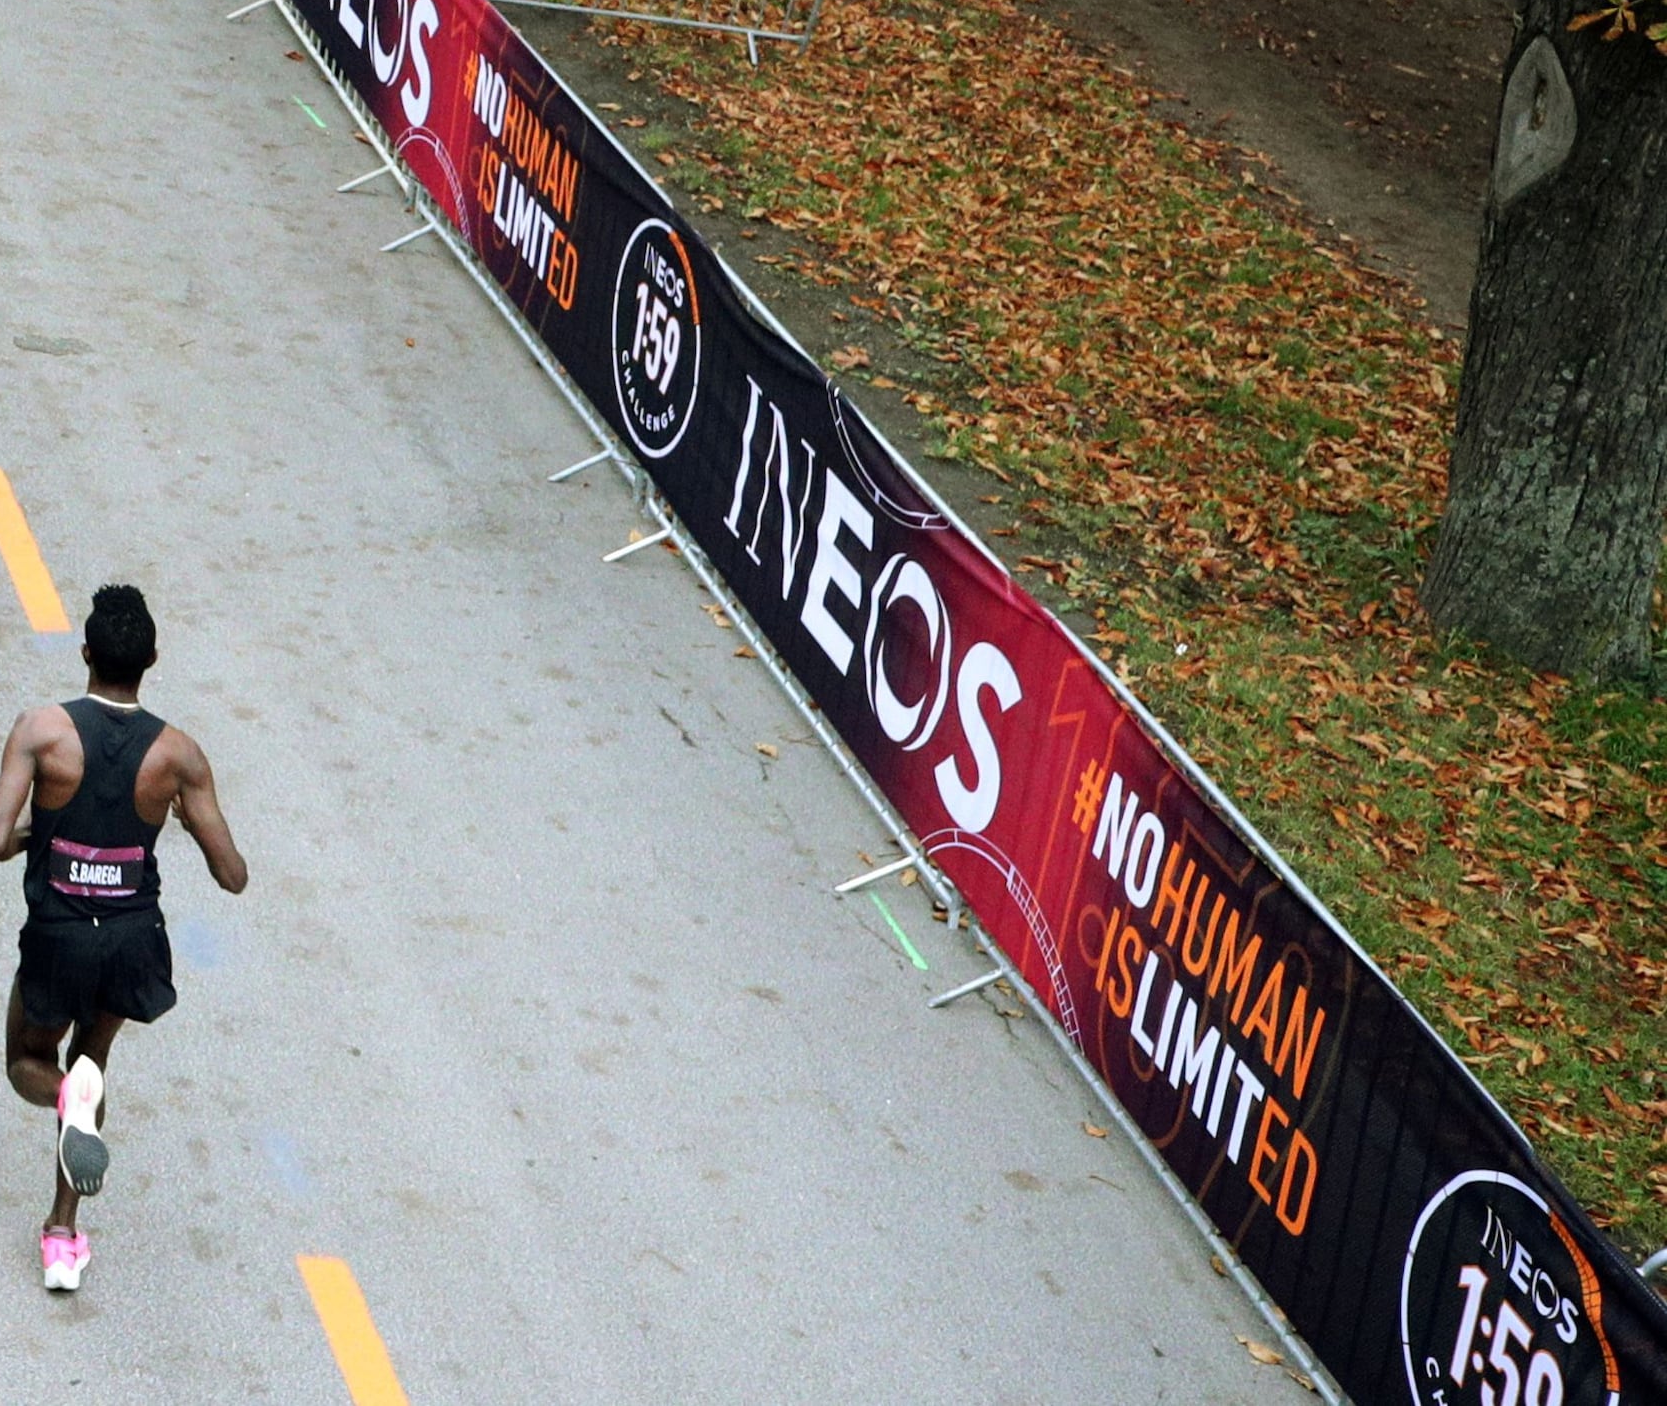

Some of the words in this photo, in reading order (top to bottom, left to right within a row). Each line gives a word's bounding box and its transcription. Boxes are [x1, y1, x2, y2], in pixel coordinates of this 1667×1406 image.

[464, 49, 579, 223] #NOHUMAN
[477, 141, 579, 311] ISLIMITED
[643, 242, 685, 308] INEOS
[621, 349, 676, 432] CHALLENGE
[632, 281, 681, 395] 1:59
[723, 374, 1023, 834] INEOS
[68, 860, 123, 886] S.BAREGA
[1071, 758, 1325, 1101] #NOHUMAN
[1093, 909, 1318, 1237] ISLIMITED
[1480, 1206, 1581, 1344] INEOS
